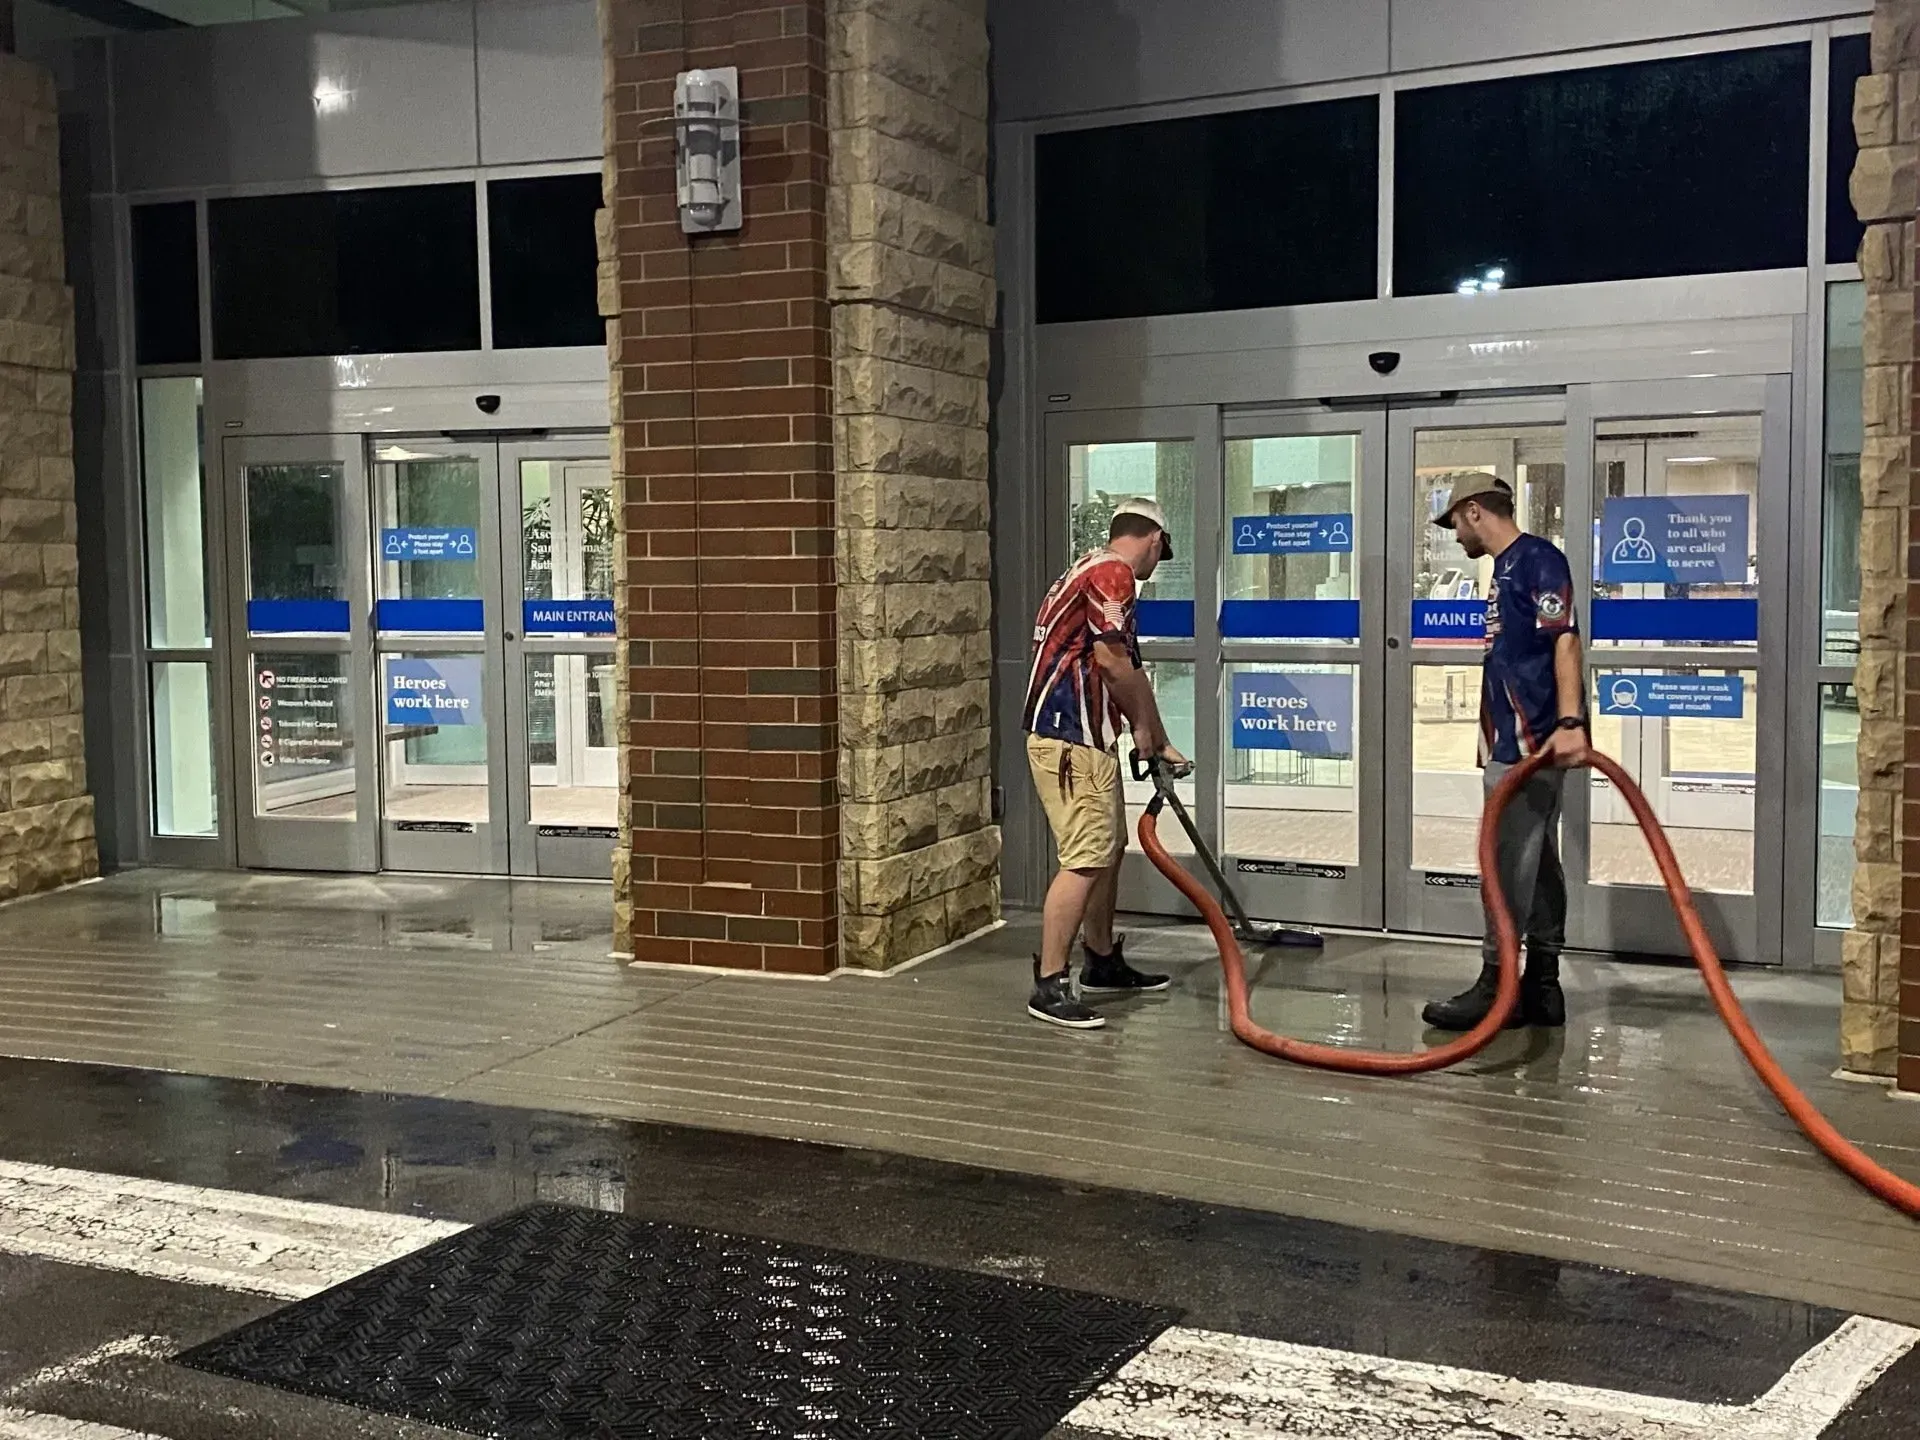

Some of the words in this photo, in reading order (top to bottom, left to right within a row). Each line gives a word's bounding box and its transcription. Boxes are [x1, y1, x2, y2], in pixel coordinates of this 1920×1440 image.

[1667, 513, 1707, 524] Thank
[1710, 514, 1732, 525] you
[1291, 521, 1318, 530] yourself
[1296, 531, 1311, 539] stay
[1667, 529, 1680, 538] to
[1682, 528, 1697, 538] all
[1700, 528, 1726, 538] who
[1667, 545, 1687, 553] are
[1689, 542, 1726, 553] called
[1667, 558, 1679, 568] to
[1681, 559, 1715, 568] serve
[533, 611, 564, 622] MAIN
[566, 611, 615, 622] ENTRAN
[1424, 613, 1466, 626] MAIN
[393, 675, 446, 690] Heroes
[1652, 682, 1678, 691] Please
[1707, 683, 1729, 692] mask
[393, 695, 432, 708] work
[434, 695, 470, 709] here
[1240, 692, 1308, 709] Heroes
[1648, 692, 1664, 700] that
[1693, 694, 1711, 702] your
[1240, 714, 1289, 731] work
[1293, 714, 1337, 732] here
